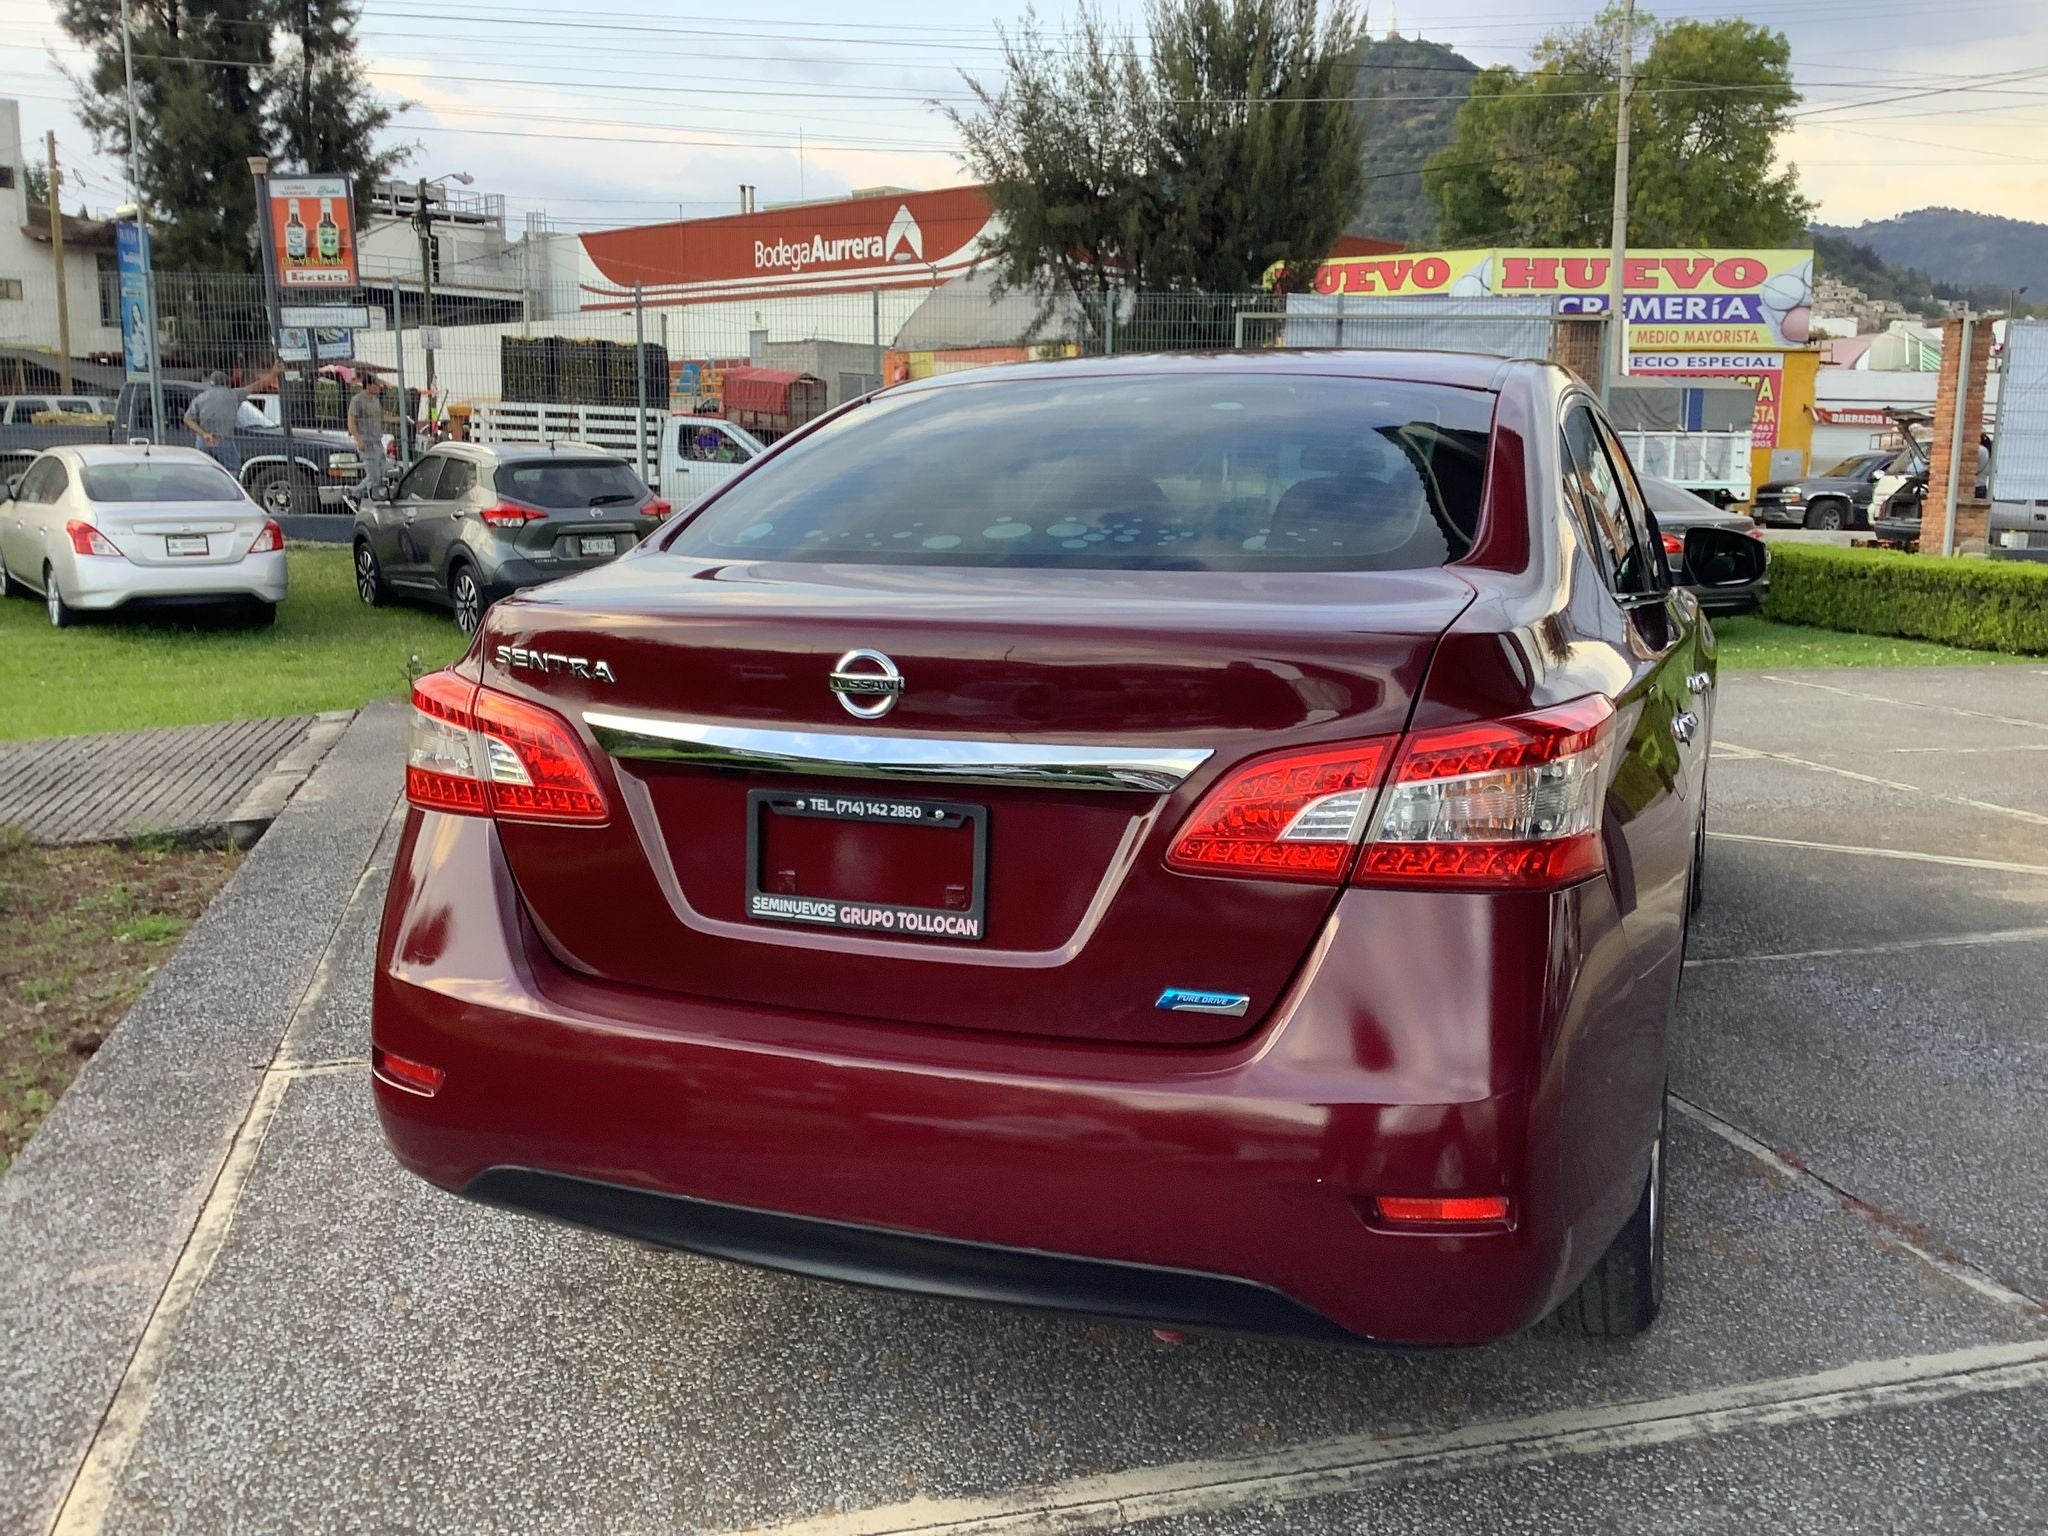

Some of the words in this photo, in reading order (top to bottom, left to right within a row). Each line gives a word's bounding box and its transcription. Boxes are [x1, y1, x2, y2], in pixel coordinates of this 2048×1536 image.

[1274, 257, 1451, 296] UEVO
[1501, 257, 1768, 290] HUEVO
[1636, 330, 1680, 345] MEDIO
[1683, 329, 1759, 344] MAYORISTA
[1629, 356, 1679, 368] ECIO
[1687, 356, 1776, 368] ESPECIAL
[1831, 413, 1883, 425] BARBACOA
[495, 645, 615, 683] SENTRA
[832, 678, 896, 690] NISSAN
[836, 799, 864, 817] (714)
[866, 802, 888, 816] 142
[889, 804, 921, 819] 2850
[752, 896, 836, 917] SEMINUEVOS
[839, 906, 894, 928] GRUPO
[896, 912, 978, 937] TOLLOCAN
[1177, 994, 1199, 1003] PURE
[1201, 997, 1228, 1005] DRIVE
